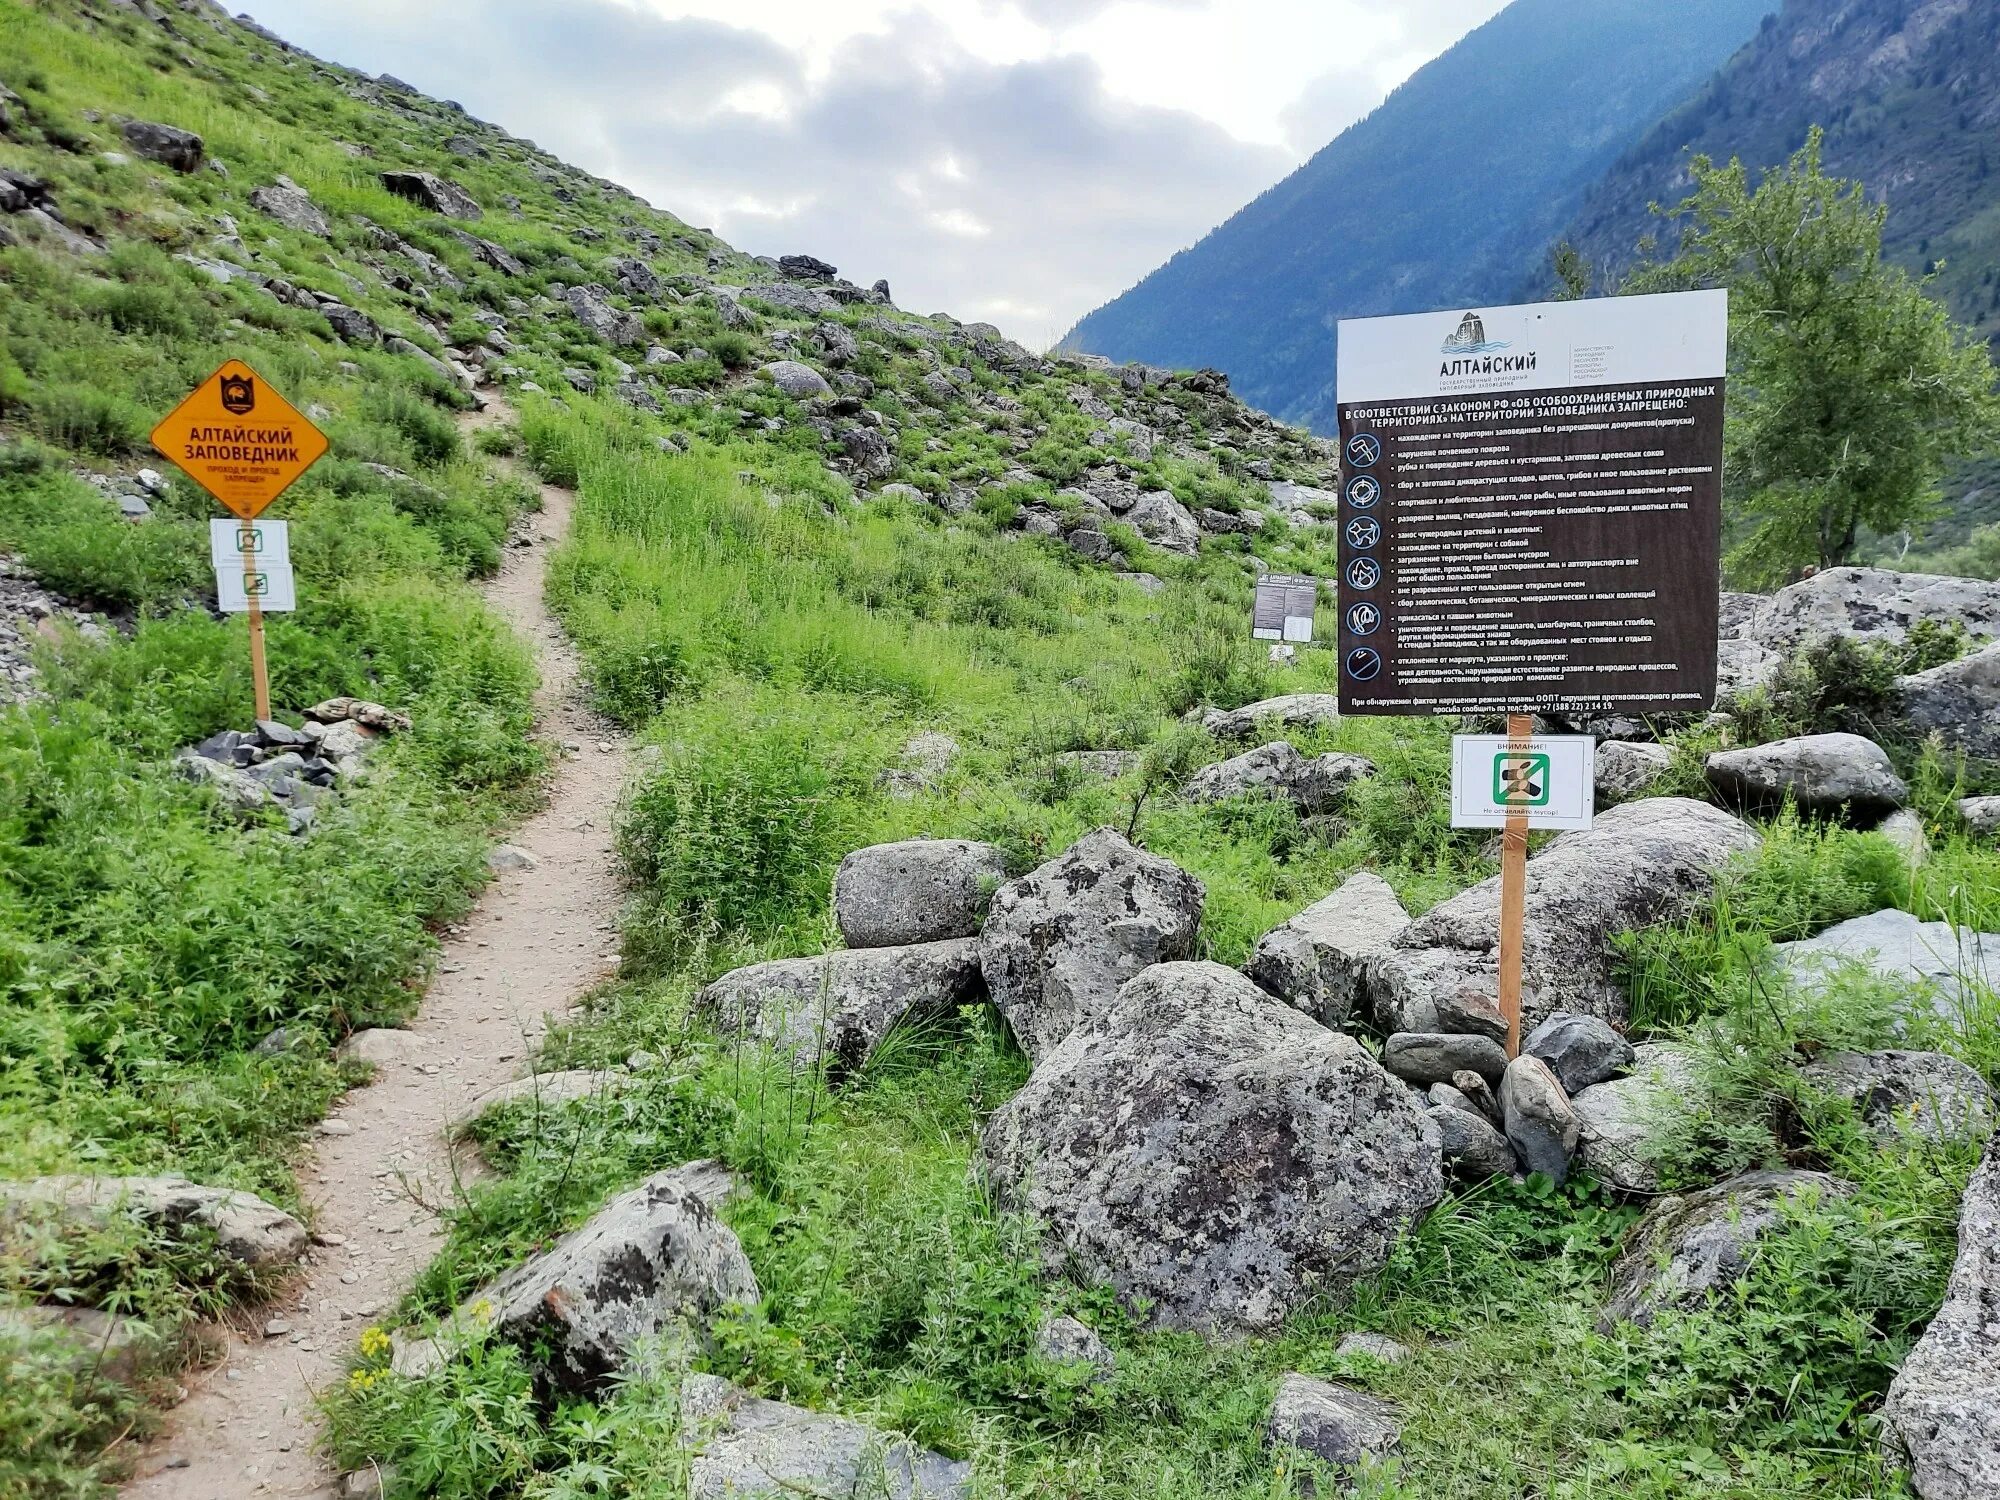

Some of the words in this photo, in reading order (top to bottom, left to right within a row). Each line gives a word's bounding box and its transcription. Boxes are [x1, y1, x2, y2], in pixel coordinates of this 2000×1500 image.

[1440, 351, 1536, 377] АЛТАЙСКИЙ
[1345, 410, 1351, 419] В
[1353, 405, 1430, 418] СООТВЕТСТВИИ
[1433, 403, 1438, 413] С
[1440, 400, 1490, 413] ЗАКОНОМ
[1494, 399, 1508, 409] РФ
[1511, 397, 1529, 407] «ОБ
[1532, 390, 1642, 406] ОСОБООХРАНЯЕМЫХ
[1645, 386, 1714, 399] ПРИРОДНЫХ
[1370, 414, 1447, 427] ТЕРРИТОРИЯХ»
[1450, 413, 1463, 422] НА
[1465, 408, 1533, 421] ТЕРРИТОРИИ
[1537, 403, 1615, 416] ЗАПОВЕДНИКА
[1617, 398, 1687, 412] ЗАПРЕЩЕНО:
[190, 425, 293, 444] АЛТАЙСКИЙ
[184, 444, 300, 464] ЗАПОВЕДНИК
[1552, 702, 1569, 712] (388
[1571, 702, 1583, 711] 22)
[1585, 702, 1589, 710] 2
[1591, 702, 1600, 710] 14
[1602, 701, 1614, 709] 19.
